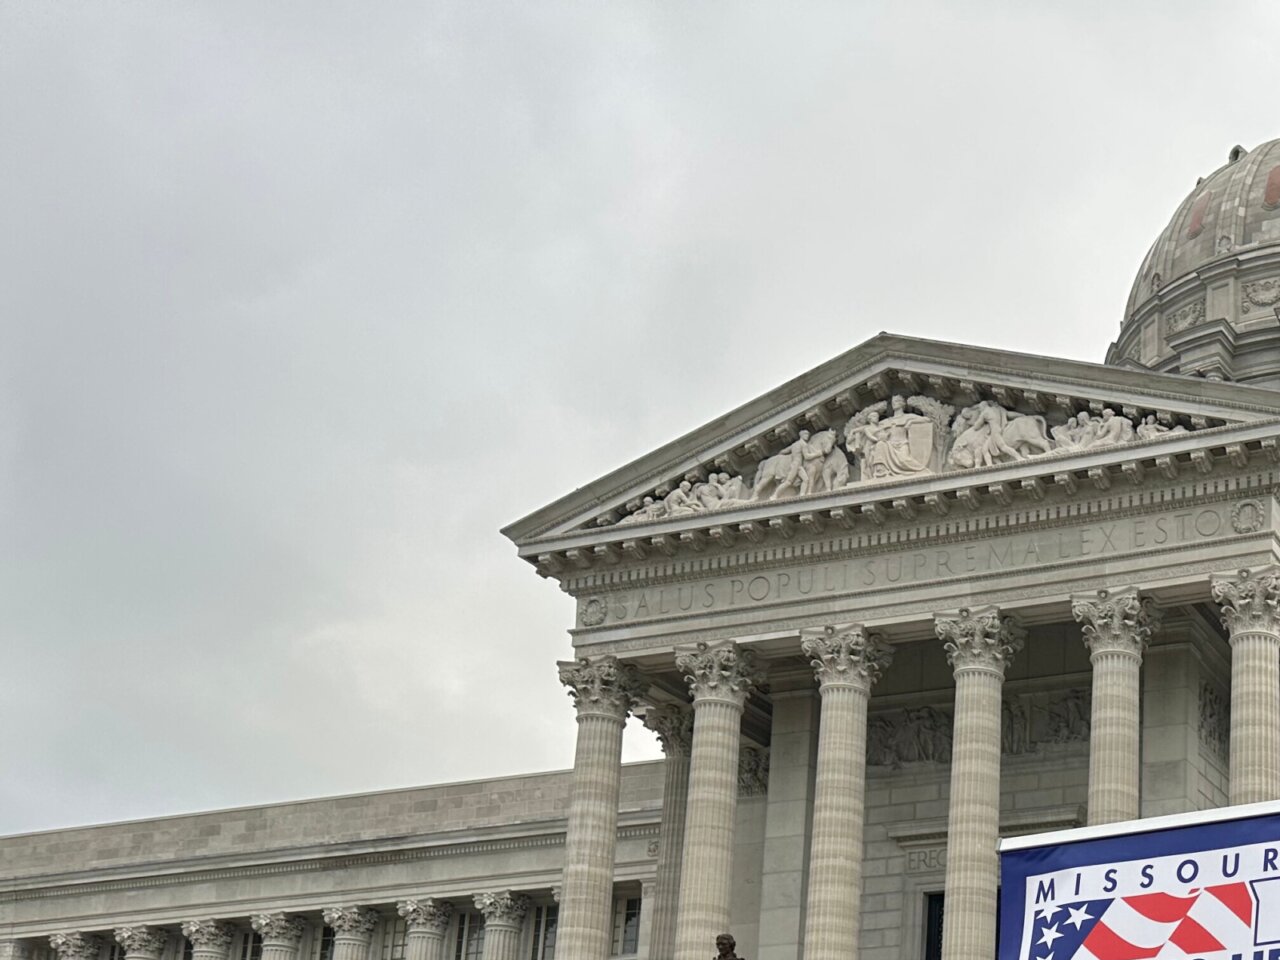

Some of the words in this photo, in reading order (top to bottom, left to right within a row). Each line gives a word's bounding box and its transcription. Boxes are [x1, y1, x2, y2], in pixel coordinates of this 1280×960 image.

[615, 583, 715, 620] SALUS
[731, 564, 848, 606] POPULI
[862, 544, 1041, 586] SUPREMA
[1057, 524, 1116, 559] LEX
[1133, 509, 1222, 548] ESTO
